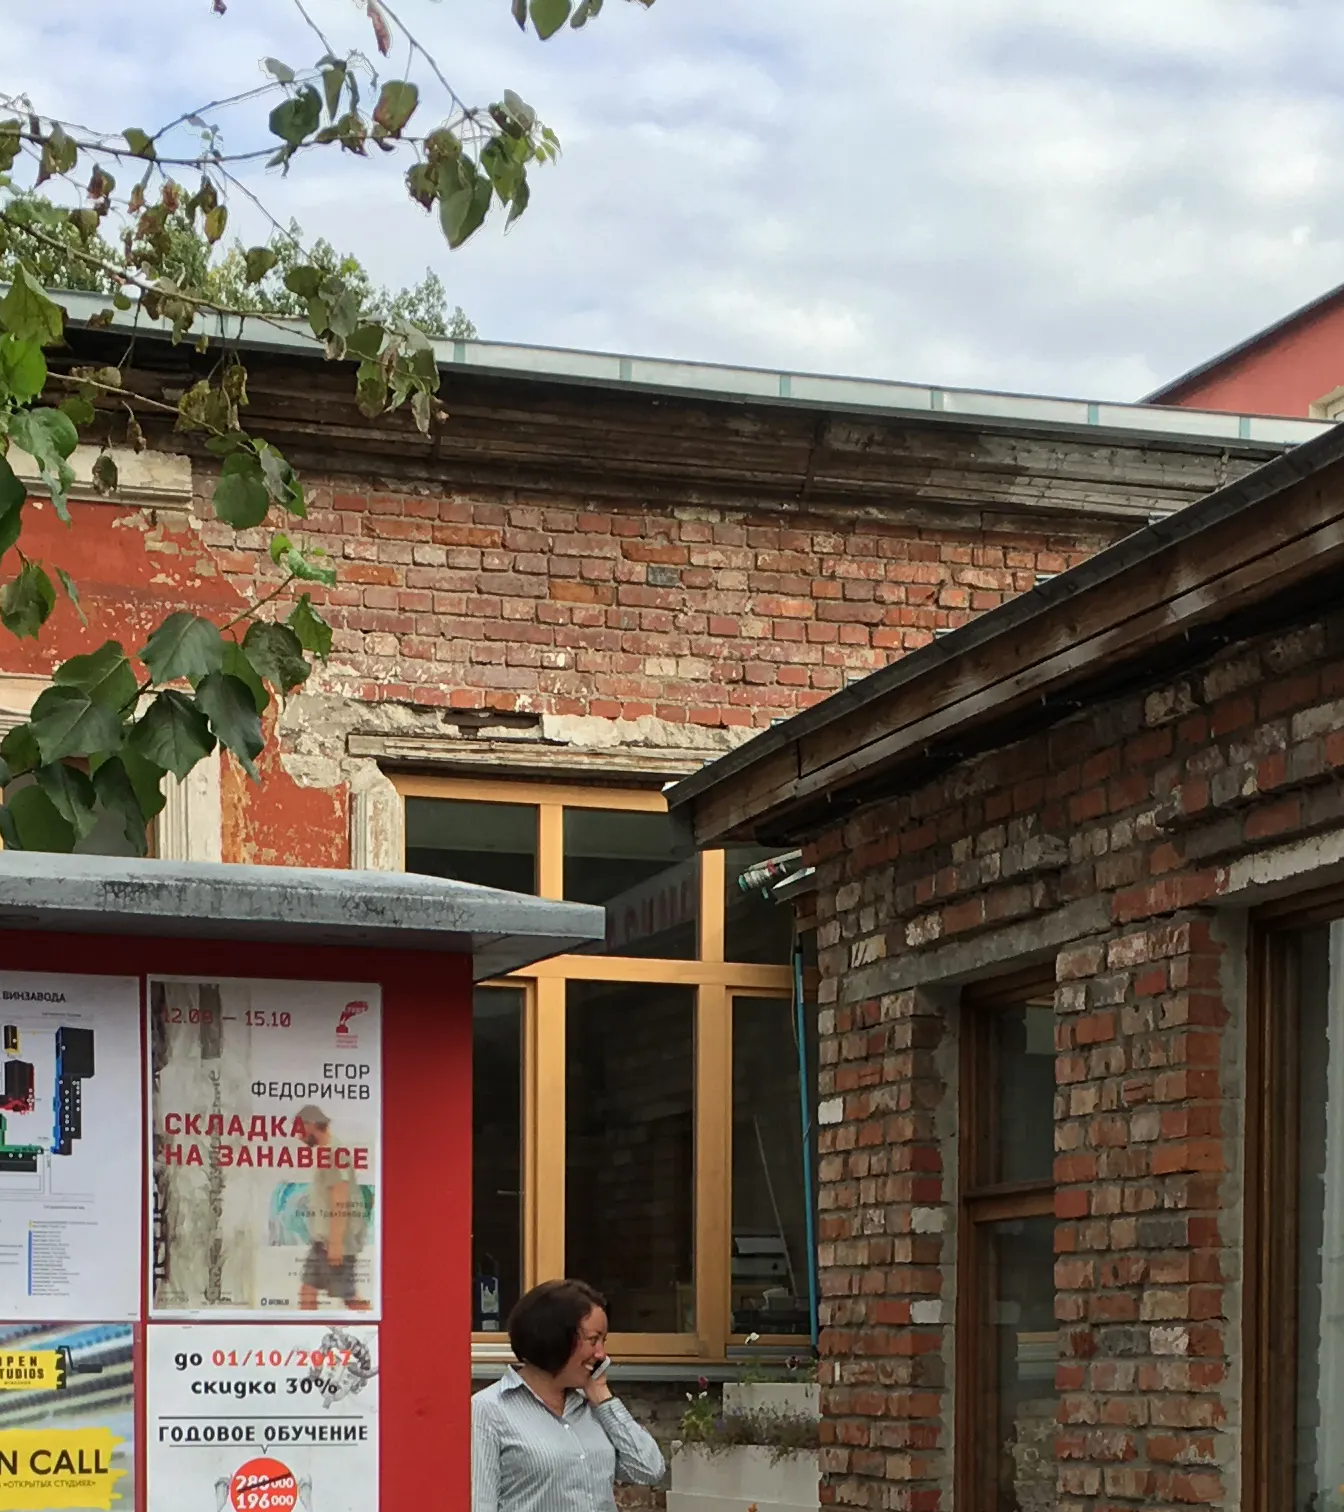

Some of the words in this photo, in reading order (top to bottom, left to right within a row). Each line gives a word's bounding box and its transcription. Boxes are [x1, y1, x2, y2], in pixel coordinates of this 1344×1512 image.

[2, 990, 67, 1003] ВИНЗАВОДА
[245, 1011, 291, 1027] 15.10
[323, 1063, 370, 1079] ЕГОР
[251, 1081, 370, 1101] ФЕДОРИЧЕВ
[164, 1112, 307, 1142] СКЛАДКА
[165, 1143, 204, 1166] НА
[217, 1145, 369, 1169] ЗАНАВЕСЕ
[174, 1352, 203, 1371] до
[212, 1349, 352, 1367] 01/10/2017
[191, 1379, 277, 1399] скидка
[285, 1377, 339, 1395] 30%
[158, 1426, 256, 1442] ГОДОВОЕ
[264, 1425, 368, 1442] ОБУЧЕНИЕ
[29, 1449, 108, 1475] CALL
[3, 1480, 52, 1489] «ОТКРЫТЫХ
[236, 1492, 270, 1509] 196
